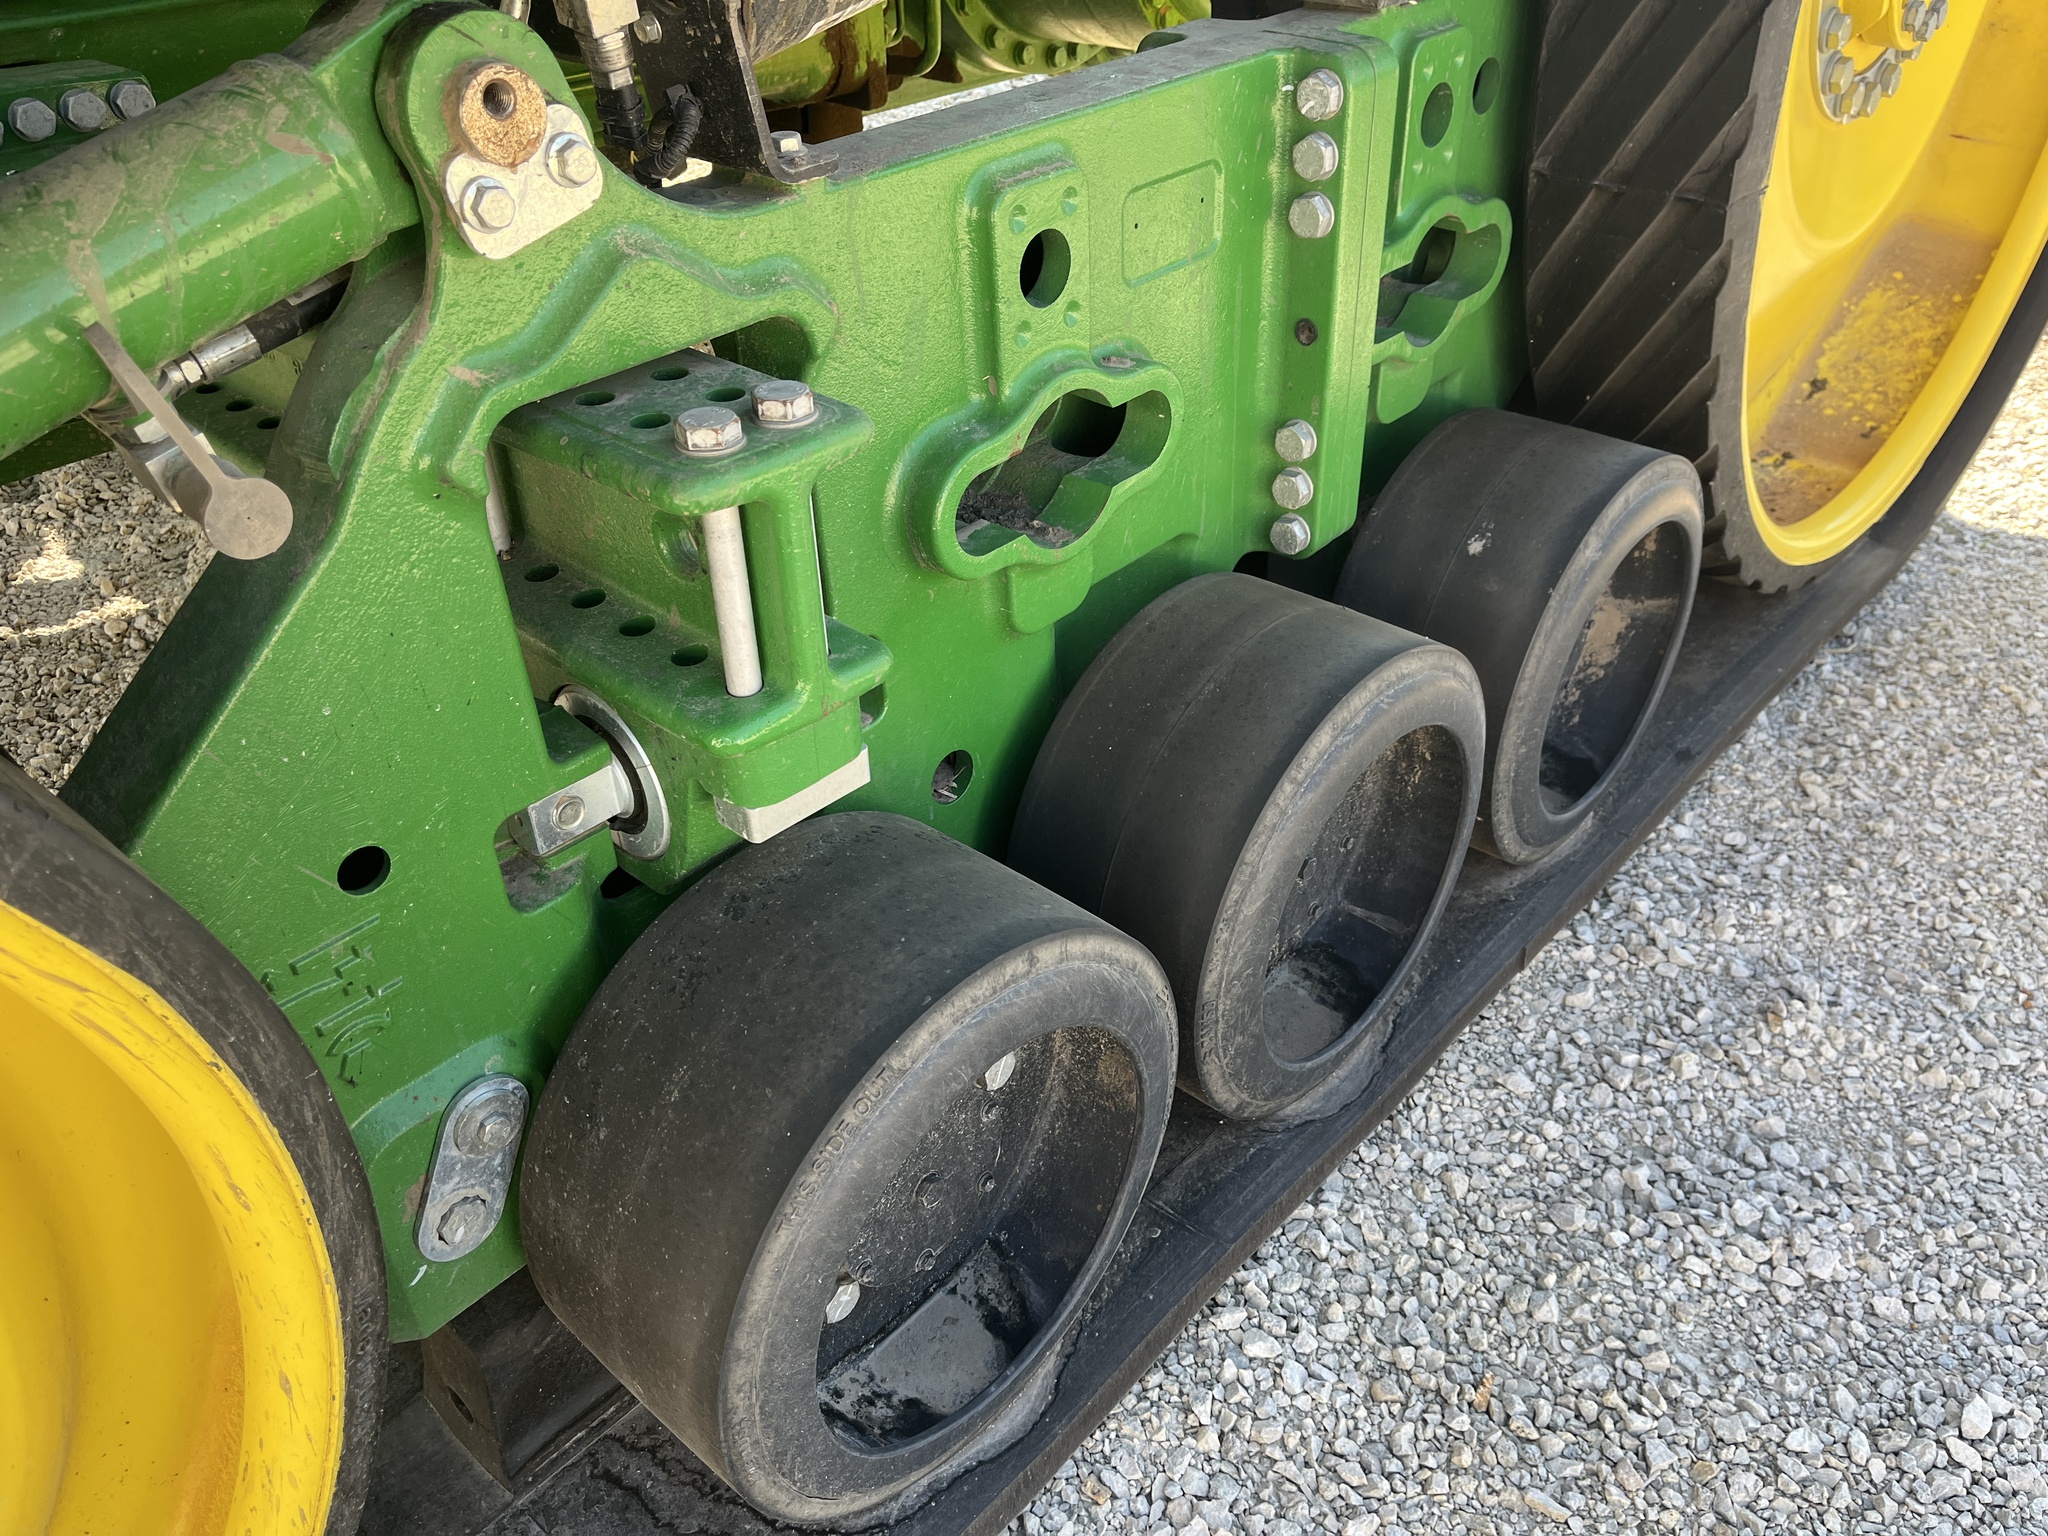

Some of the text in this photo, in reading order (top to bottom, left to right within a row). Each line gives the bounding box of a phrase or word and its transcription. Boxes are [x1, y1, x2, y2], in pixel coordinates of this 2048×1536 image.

[775, 1066, 891, 1234] THIS SIDE OUT
